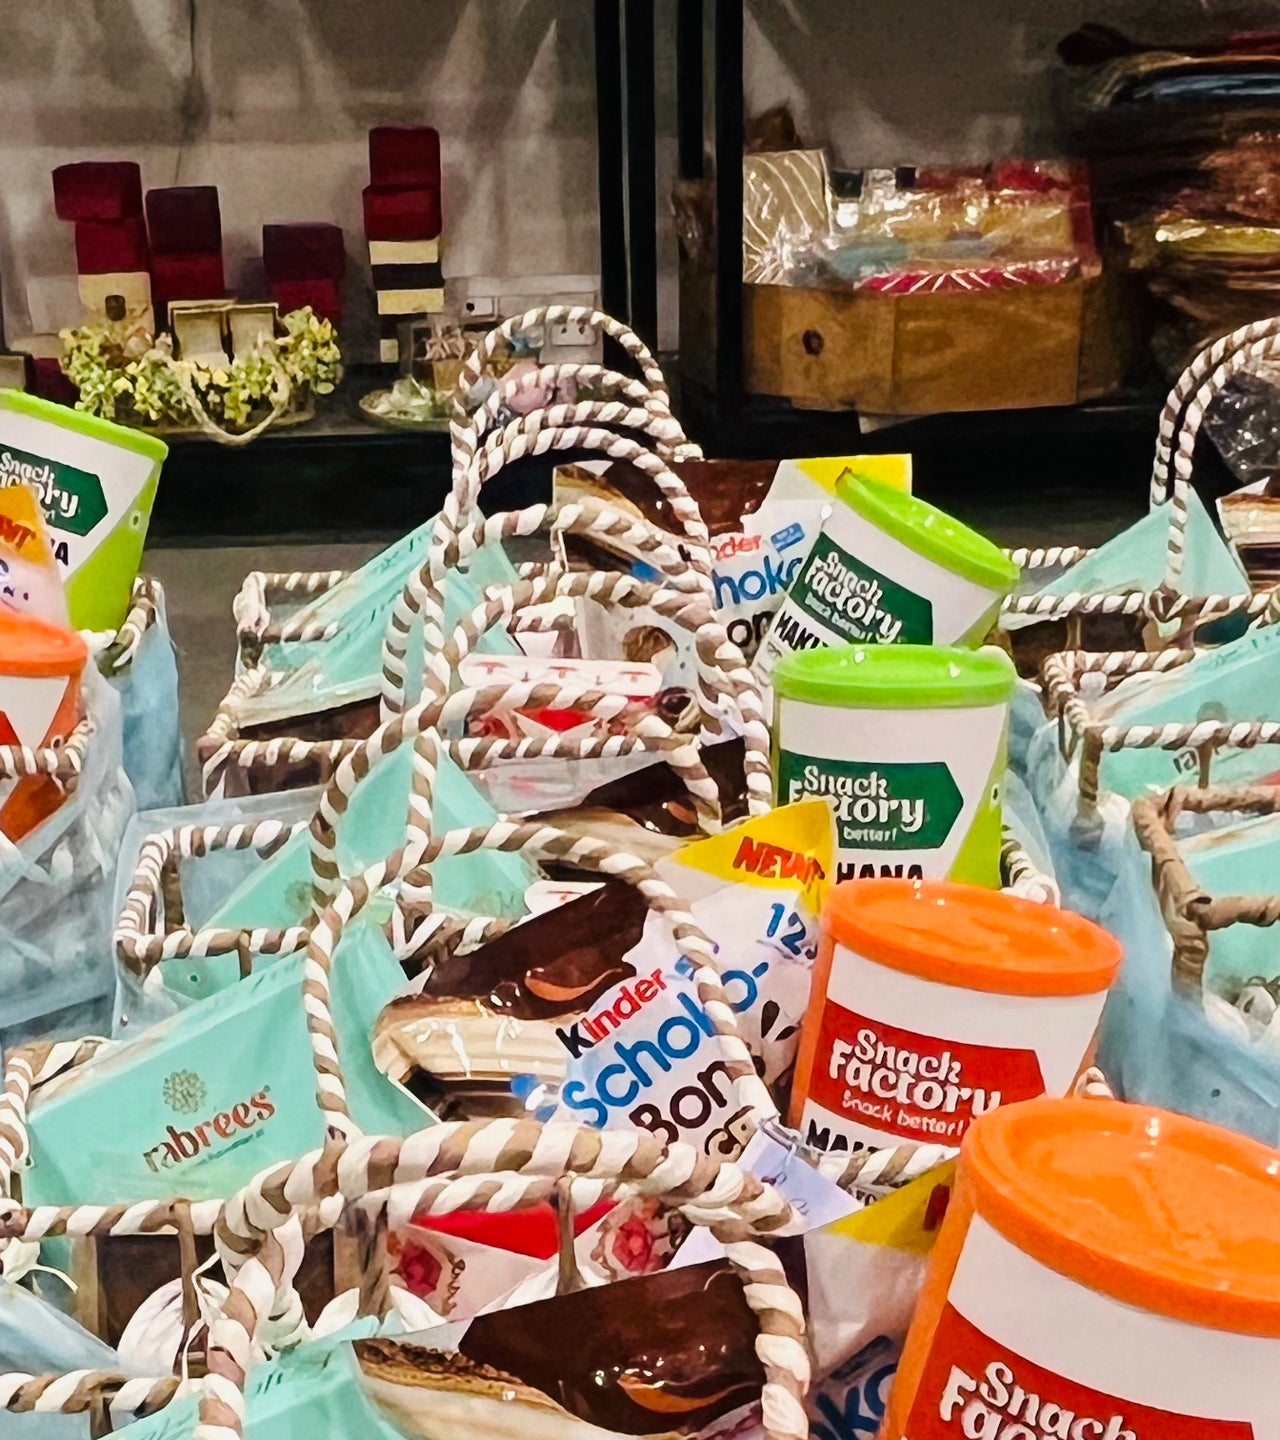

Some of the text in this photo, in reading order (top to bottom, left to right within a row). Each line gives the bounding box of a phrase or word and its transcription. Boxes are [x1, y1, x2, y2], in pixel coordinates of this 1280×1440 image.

[804, 554, 904, 644] Factory
[826, 551, 883, 606] Snack
[789, 779, 924, 833] Ftory
[803, 765, 888, 797] Snack
[555, 968, 668, 1059] Kinder
[828, 1037, 1003, 1120] Factory
[854, 1028, 963, 1084] Snack
[142, 1084, 277, 1173] rabrees
[897, 1108, 965, 1137] better!
